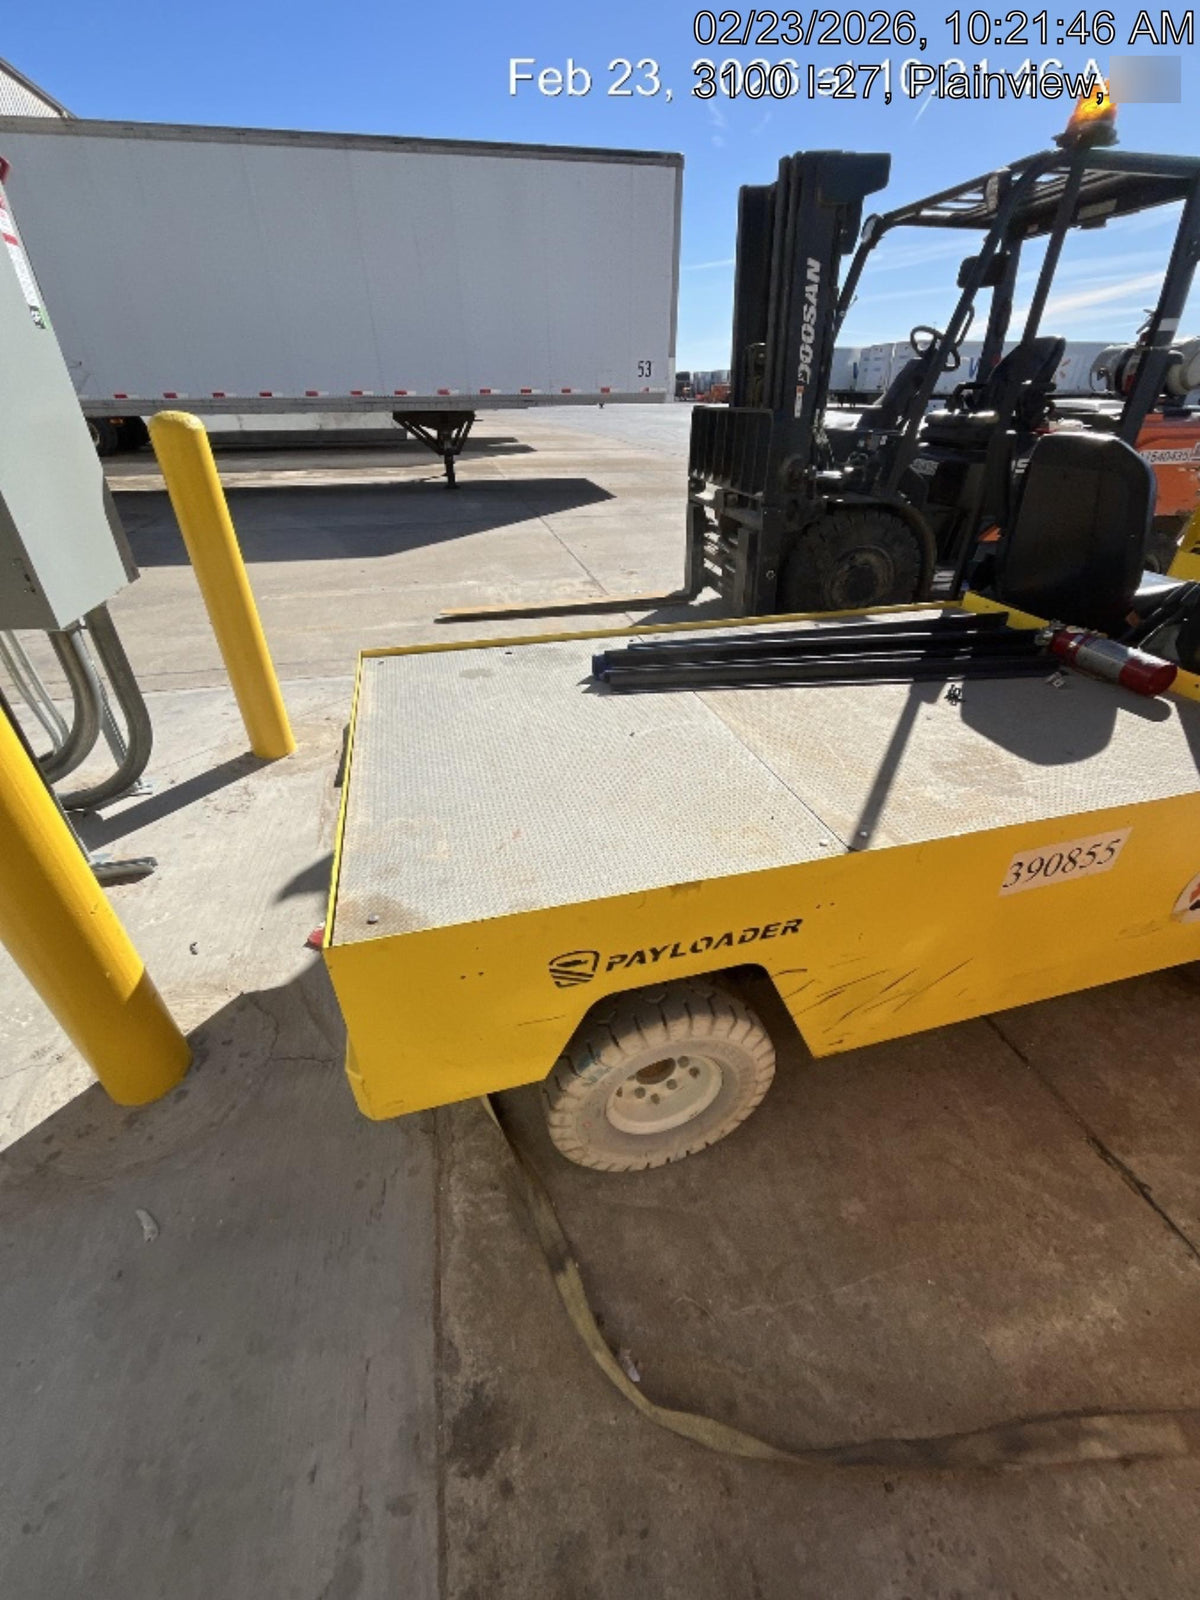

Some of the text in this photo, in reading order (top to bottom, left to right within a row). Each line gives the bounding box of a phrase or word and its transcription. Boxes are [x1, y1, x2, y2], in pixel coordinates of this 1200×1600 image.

[797, 256, 822, 385] DOOSAN
[637, 360, 652, 378] 53
[1001, 838, 1122, 889] 390855
[605, 918, 804, 973] PAYLOADER
